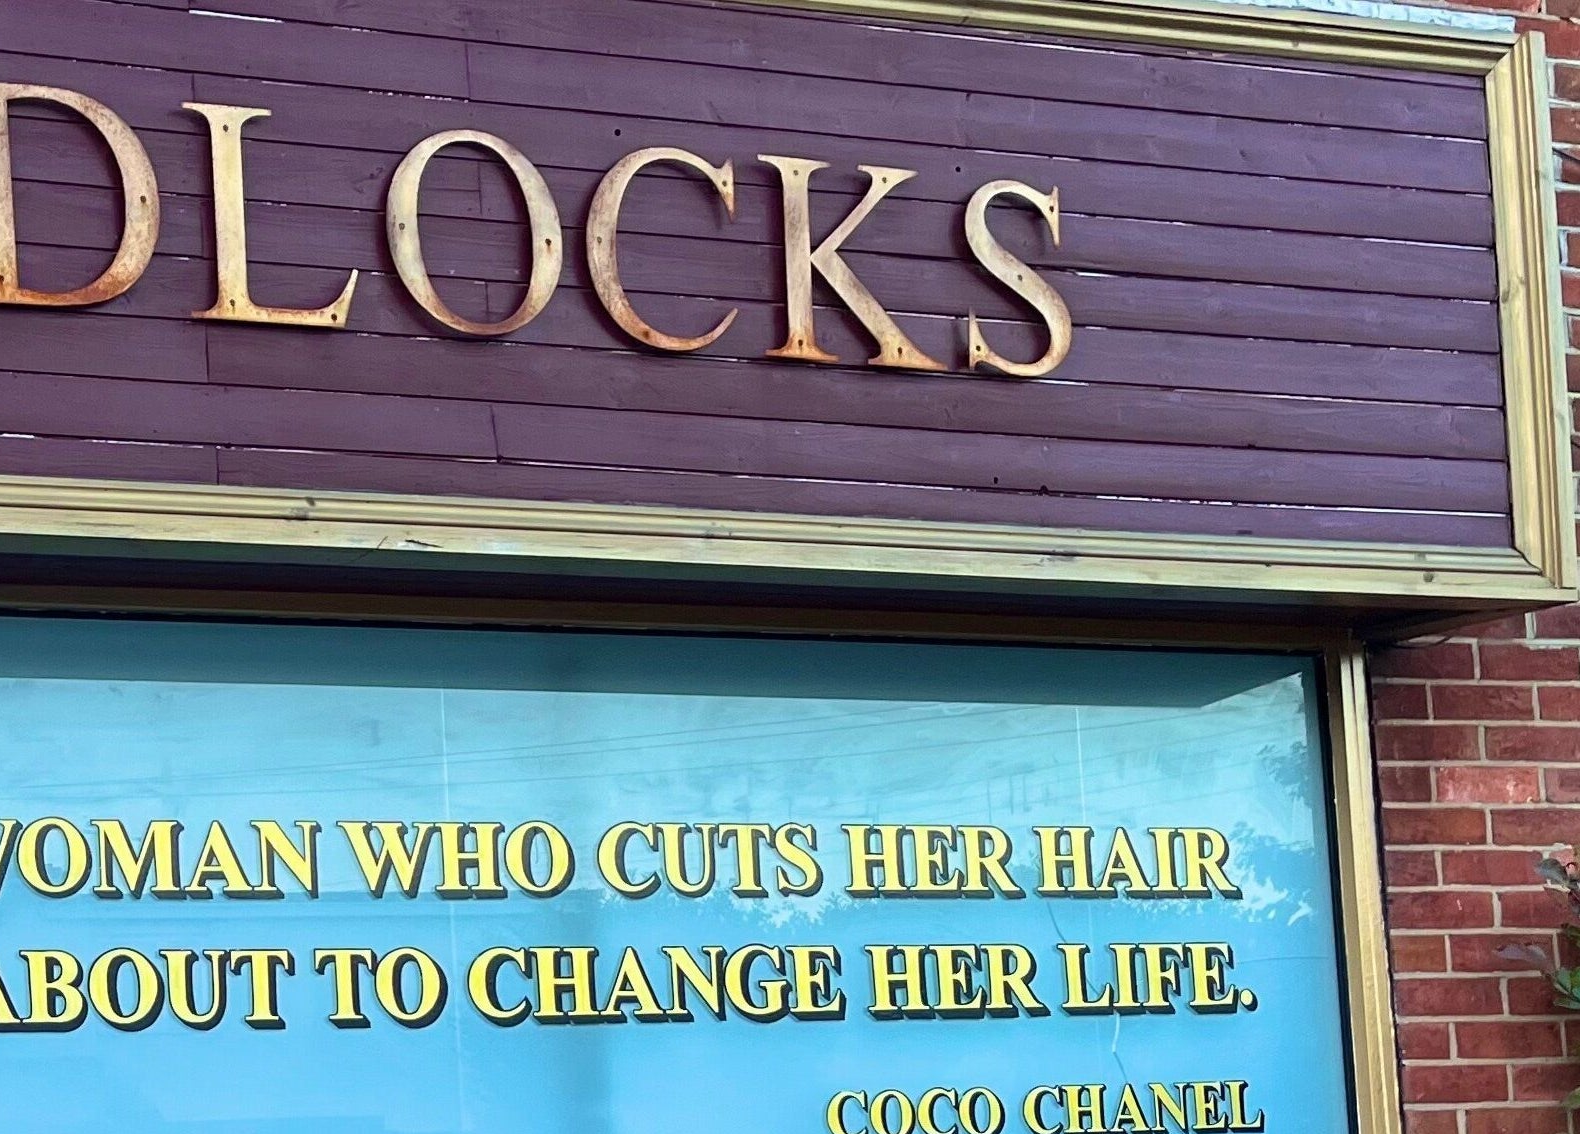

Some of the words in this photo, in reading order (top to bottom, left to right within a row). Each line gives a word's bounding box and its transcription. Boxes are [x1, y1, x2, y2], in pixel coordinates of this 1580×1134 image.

[337, 820, 575, 899] WHO
[597, 821, 823, 898] CUTS
[842, 824, 1025, 899] HER
[1035, 826, 1243, 899] HAIR
[315, 947, 448, 1029] TO
[467, 944, 846, 1027] CHANGE
[865, 943, 1050, 1021] HER
[1057, 943, 1258, 1017] LIFE.
